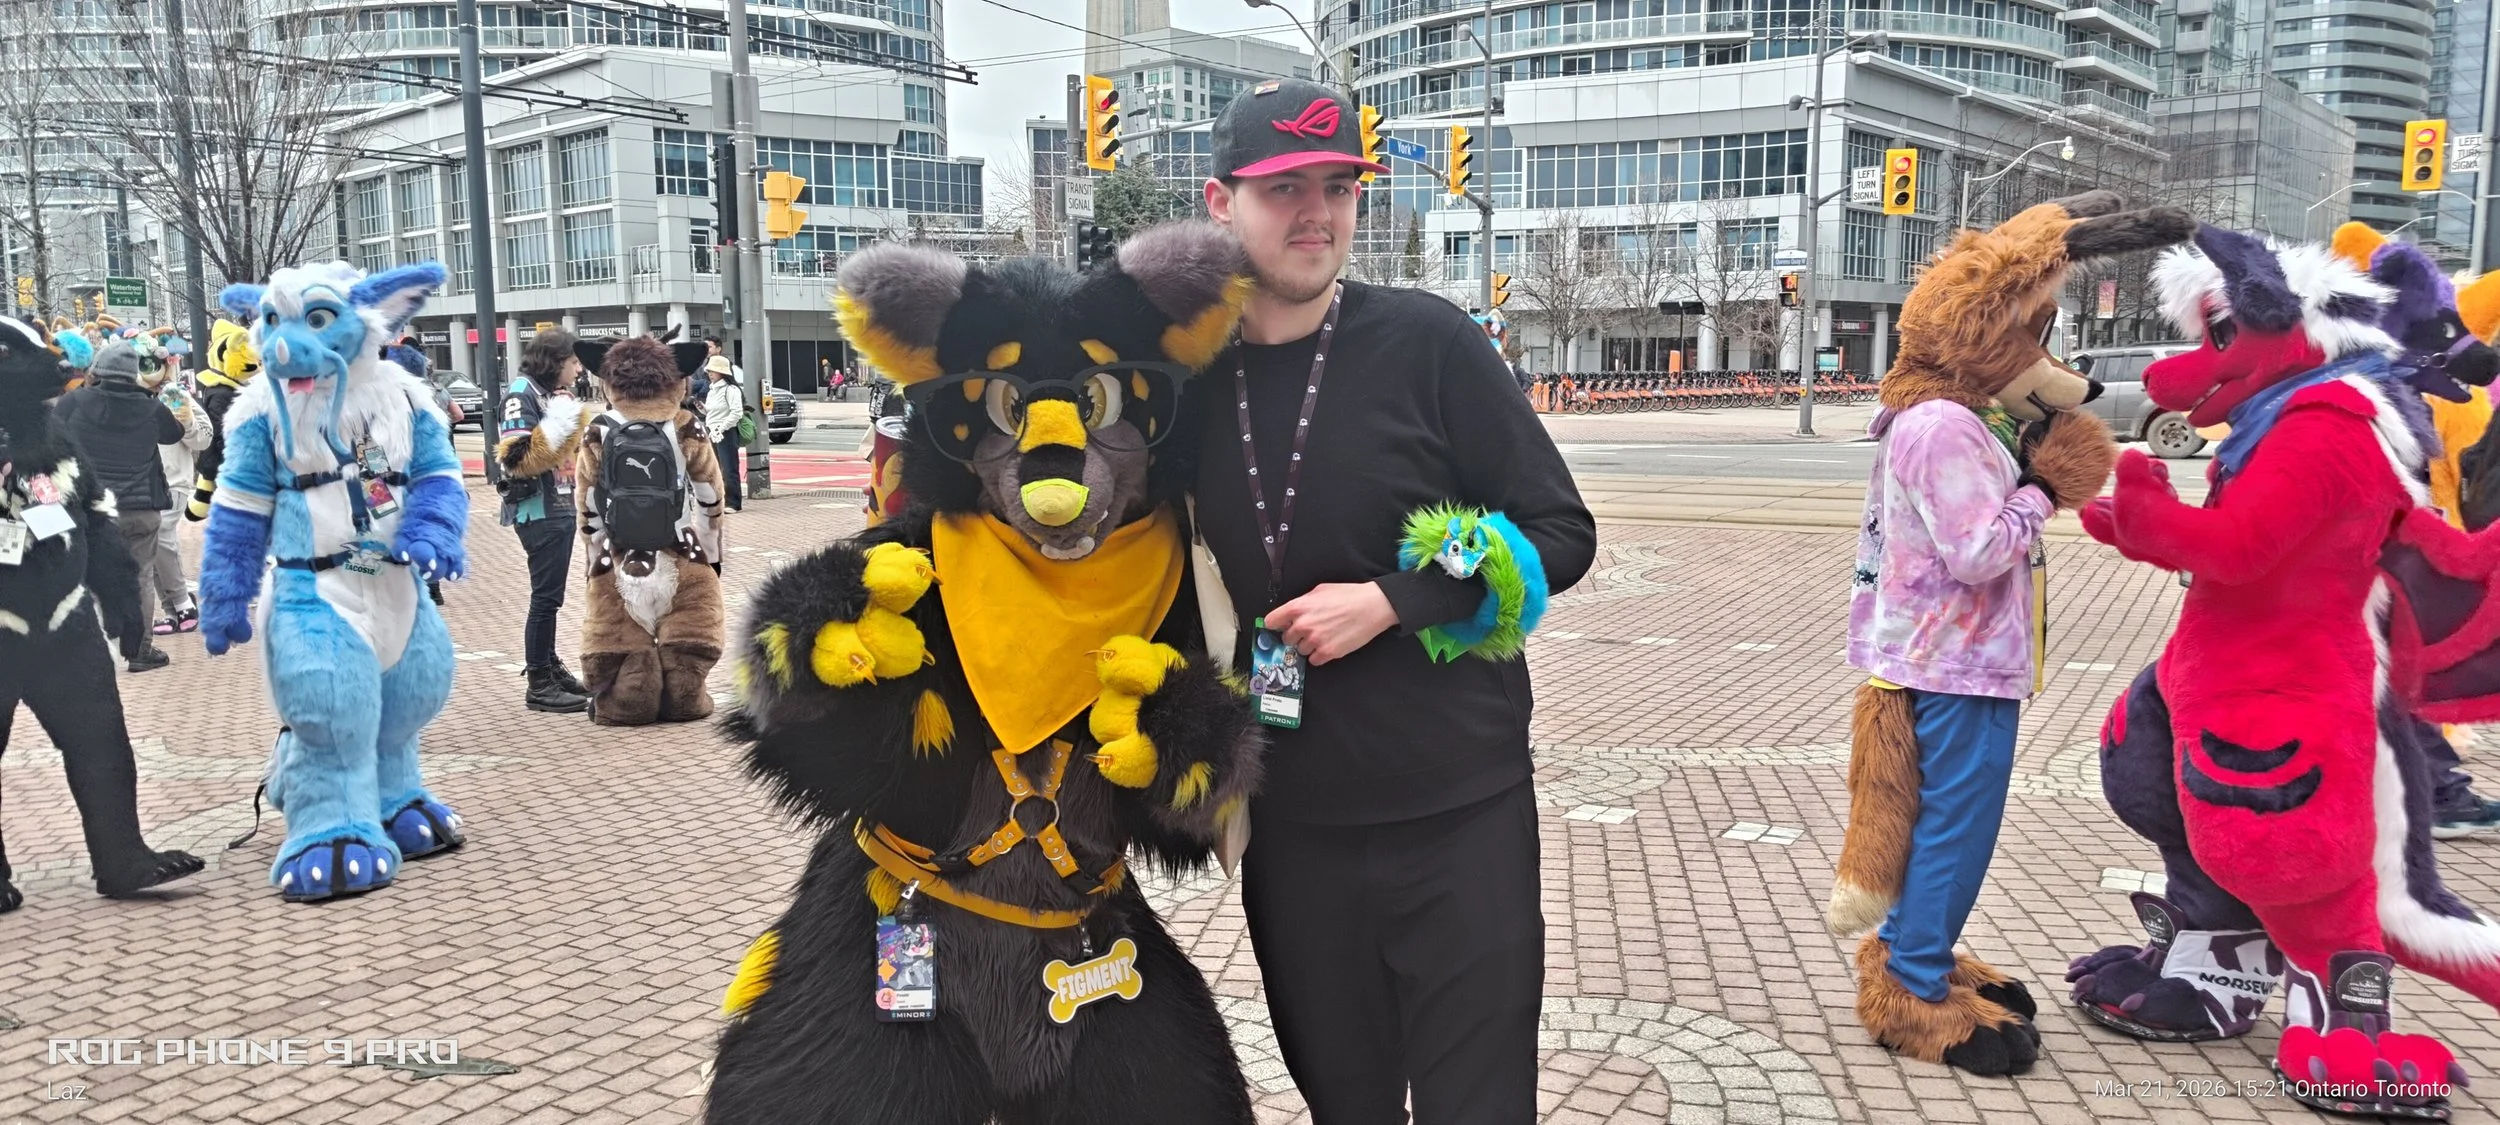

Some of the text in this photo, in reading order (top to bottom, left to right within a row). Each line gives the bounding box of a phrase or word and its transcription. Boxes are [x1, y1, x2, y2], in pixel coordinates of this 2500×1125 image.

[2459, 136, 2480, 146] LEFT
[1397, 140, 1411, 155] York
[2451, 160, 2478, 170] SIGNA
[1857, 169, 1875, 179] LEFT
[1066, 181, 1092, 196] TRANSIT
[1857, 180, 1876, 190] TURN
[1853, 191, 1878, 201] SIGNAL
[1068, 197, 1091, 211] SIGNAL
[579, 328, 608, 337] STARBUCKS
[505, 397, 521, 421] 2
[1264, 715, 1292, 725] PATRON
[1057, 956, 1130, 1004] FIGMENT
